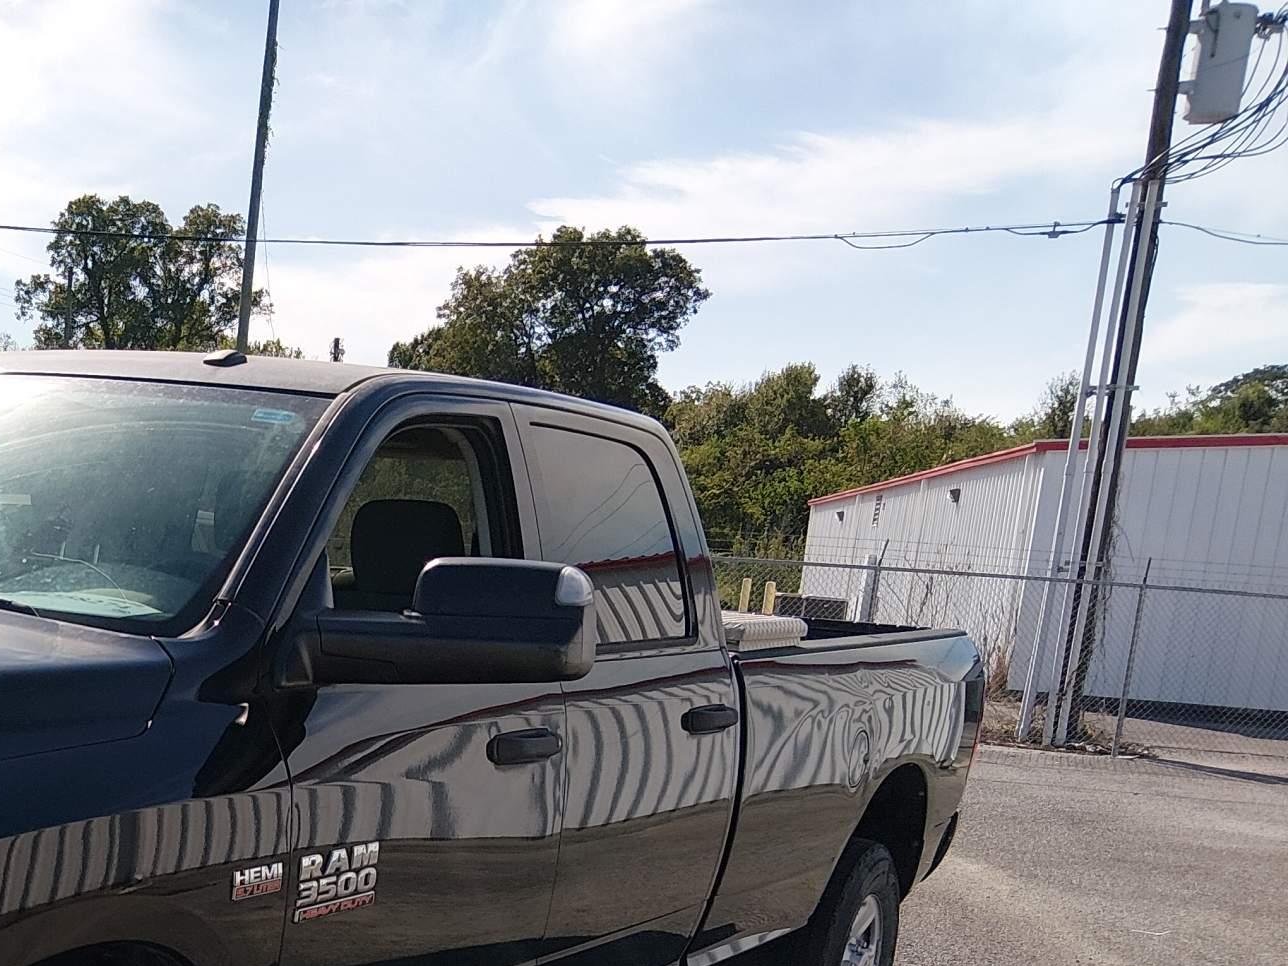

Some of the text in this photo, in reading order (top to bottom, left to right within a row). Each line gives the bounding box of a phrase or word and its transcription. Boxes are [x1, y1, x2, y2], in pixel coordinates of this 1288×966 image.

[234, 862, 283, 887] HEMI
[299, 841, 380, 881] RAM
[295, 867, 377, 907] 3500
[300, 894, 373, 920] HEAVY DUTY
